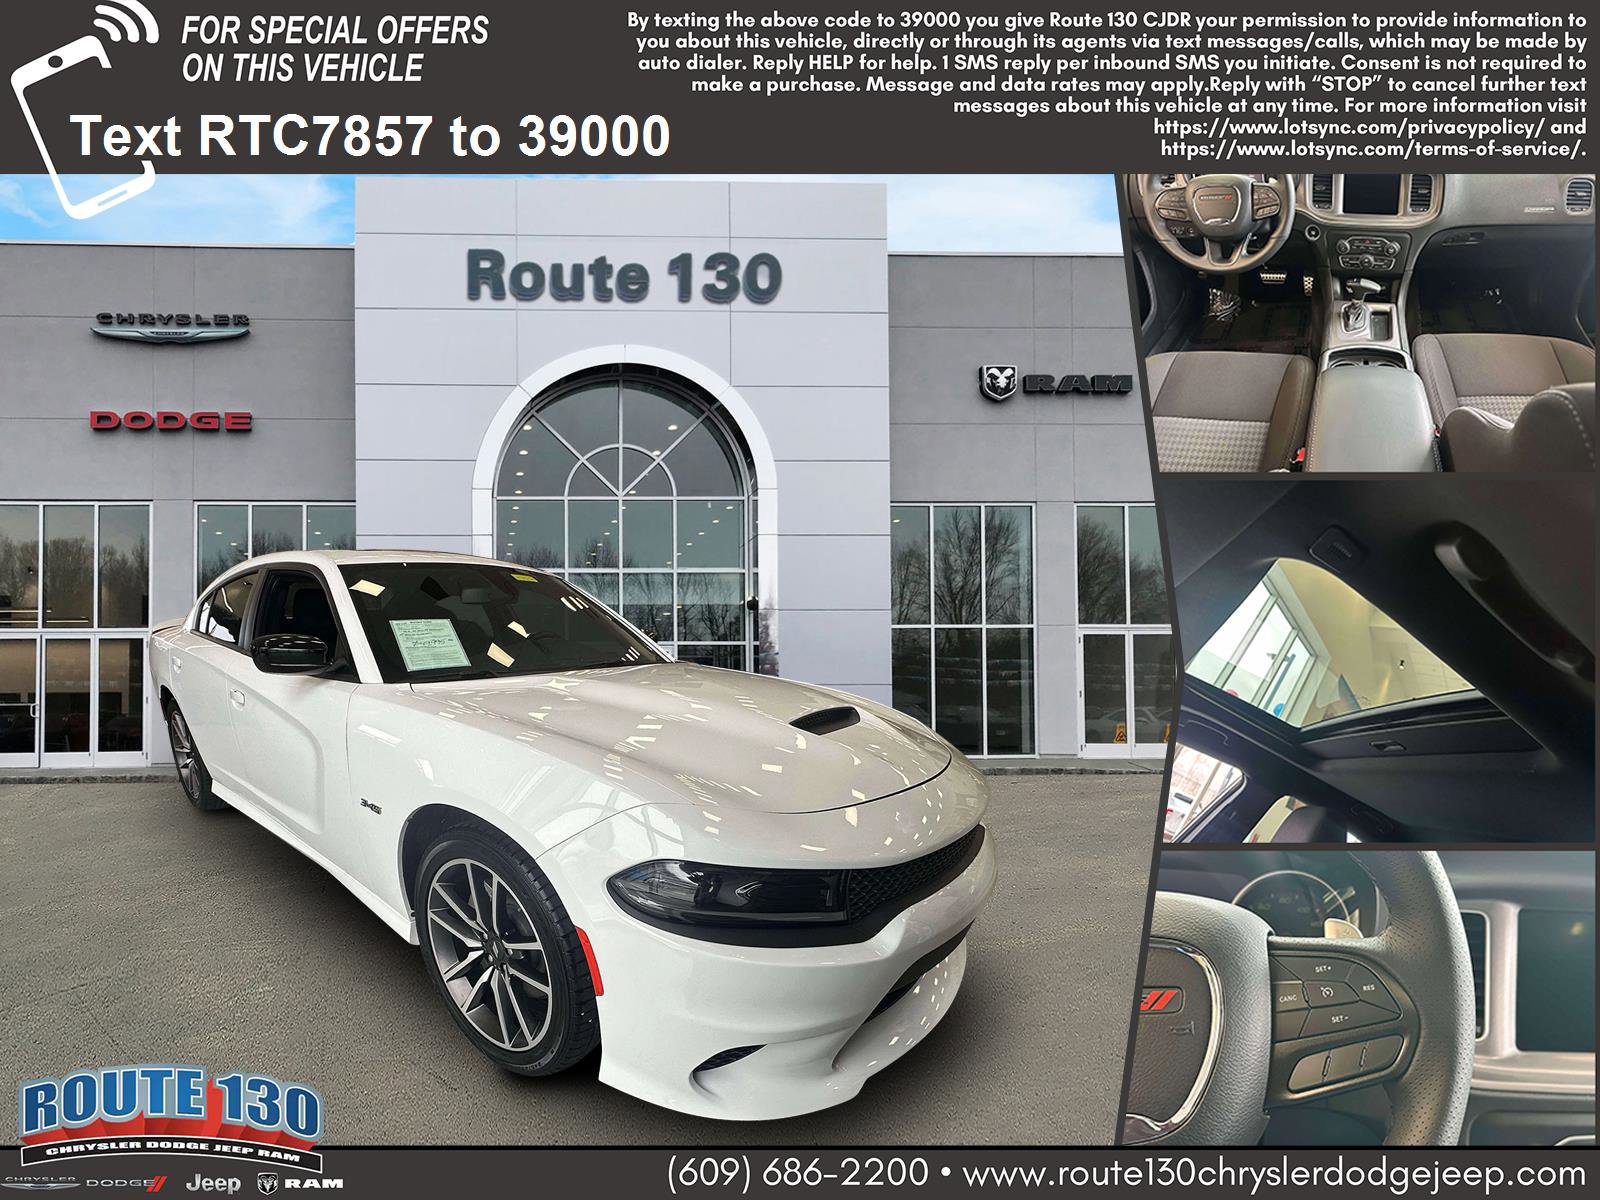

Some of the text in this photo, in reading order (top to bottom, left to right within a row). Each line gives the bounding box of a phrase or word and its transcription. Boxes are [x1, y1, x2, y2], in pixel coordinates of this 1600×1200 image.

[467, 248, 783, 304] Route 130
[96, 312, 250, 326] CHRYSLER
[1023, 374, 1133, 394] RAM
[90, 410, 252, 431] DODGE
[1279, 994, 1297, 1003] CANC
